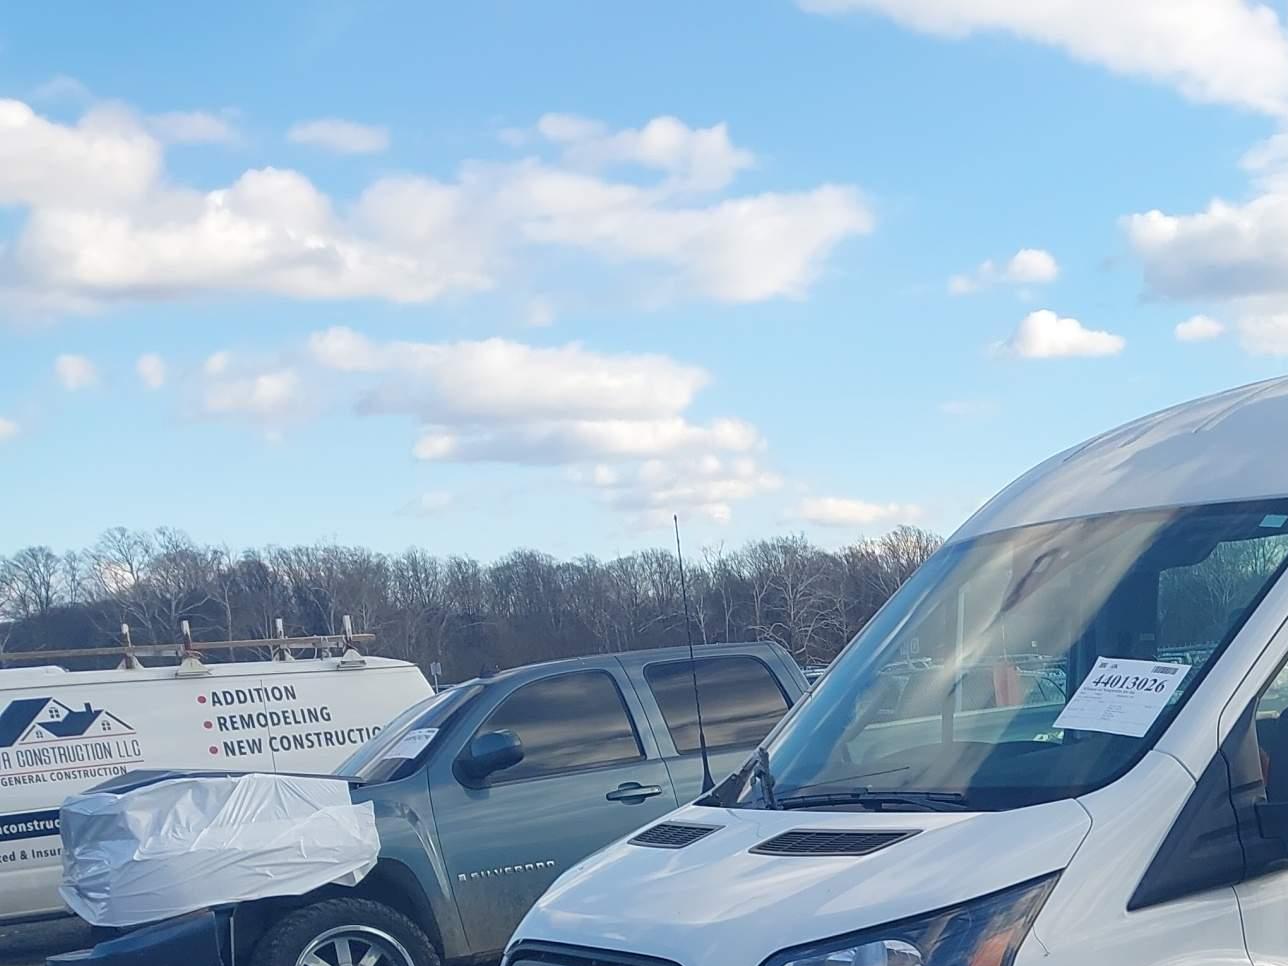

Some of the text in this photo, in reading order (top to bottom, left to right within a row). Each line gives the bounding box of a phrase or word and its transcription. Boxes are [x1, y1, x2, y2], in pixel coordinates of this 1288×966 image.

[1092, 673, 1168, 694] 44013026
[211, 685, 297, 707] ADDITION
[217, 706, 332, 732] REMODELING
[16, 742, 113, 768] CONSTRUCTION
[116, 739, 142, 758] LLC
[223, 738, 263, 757] NEW
[0, 765, 128, 787] GENERAL CONSTRUCTION
[20, 850, 28, 860] &
